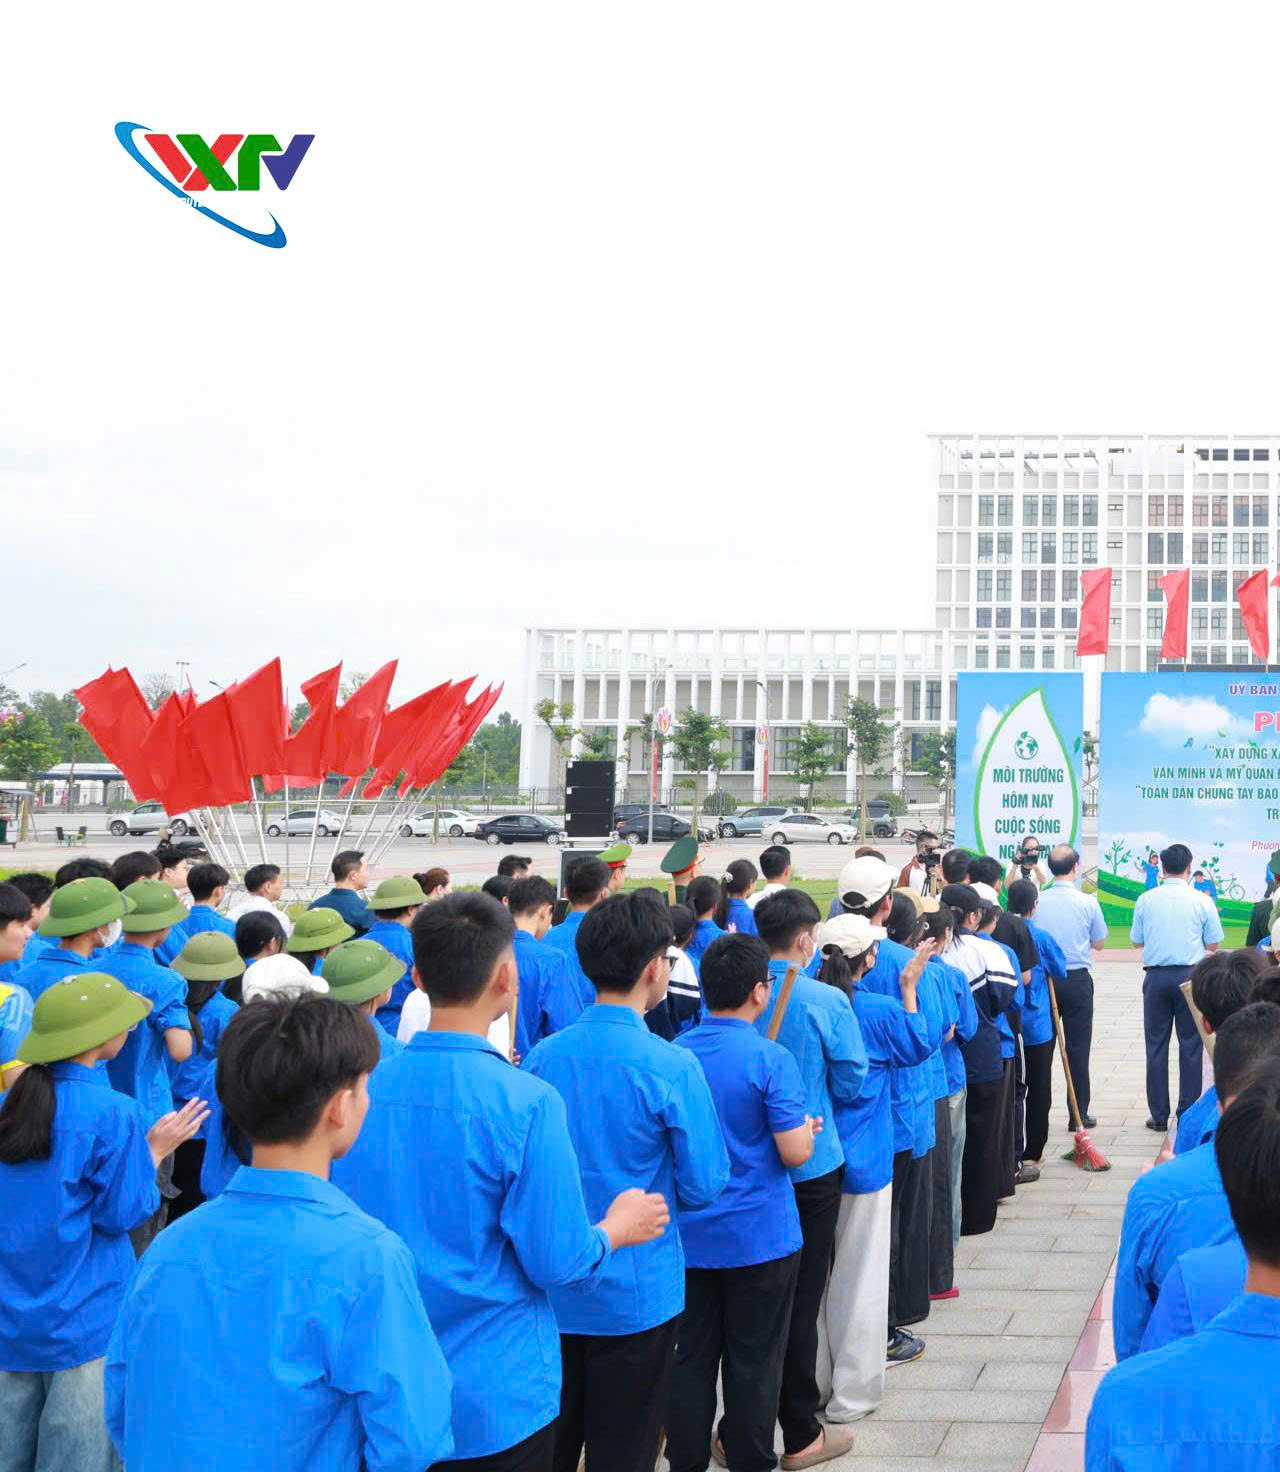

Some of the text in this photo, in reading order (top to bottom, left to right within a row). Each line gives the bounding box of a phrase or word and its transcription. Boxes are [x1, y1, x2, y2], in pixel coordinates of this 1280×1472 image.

[1250, 684, 1277, 695] BAN
[1239, 746, 1268, 761] DỰNG
[993, 764, 1064, 783] MÔI TRƯỜNG
[1153, 765, 1174, 779] VĂN
[1178, 767, 1206, 779] MINH
[1209, 765, 1222, 779] VÀ
[1246, 767, 1274, 780] QUAN
[1002, 790, 1054, 809] HÔM NAY
[1172, 784, 1194, 799] DÂN
[1197, 787, 1234, 799] CHUNG
[1237, 787, 1254, 799] TAY
[1257, 784, 1279, 800] BẢO
[995, 813, 1061, 837] CUỘC SỐNG
